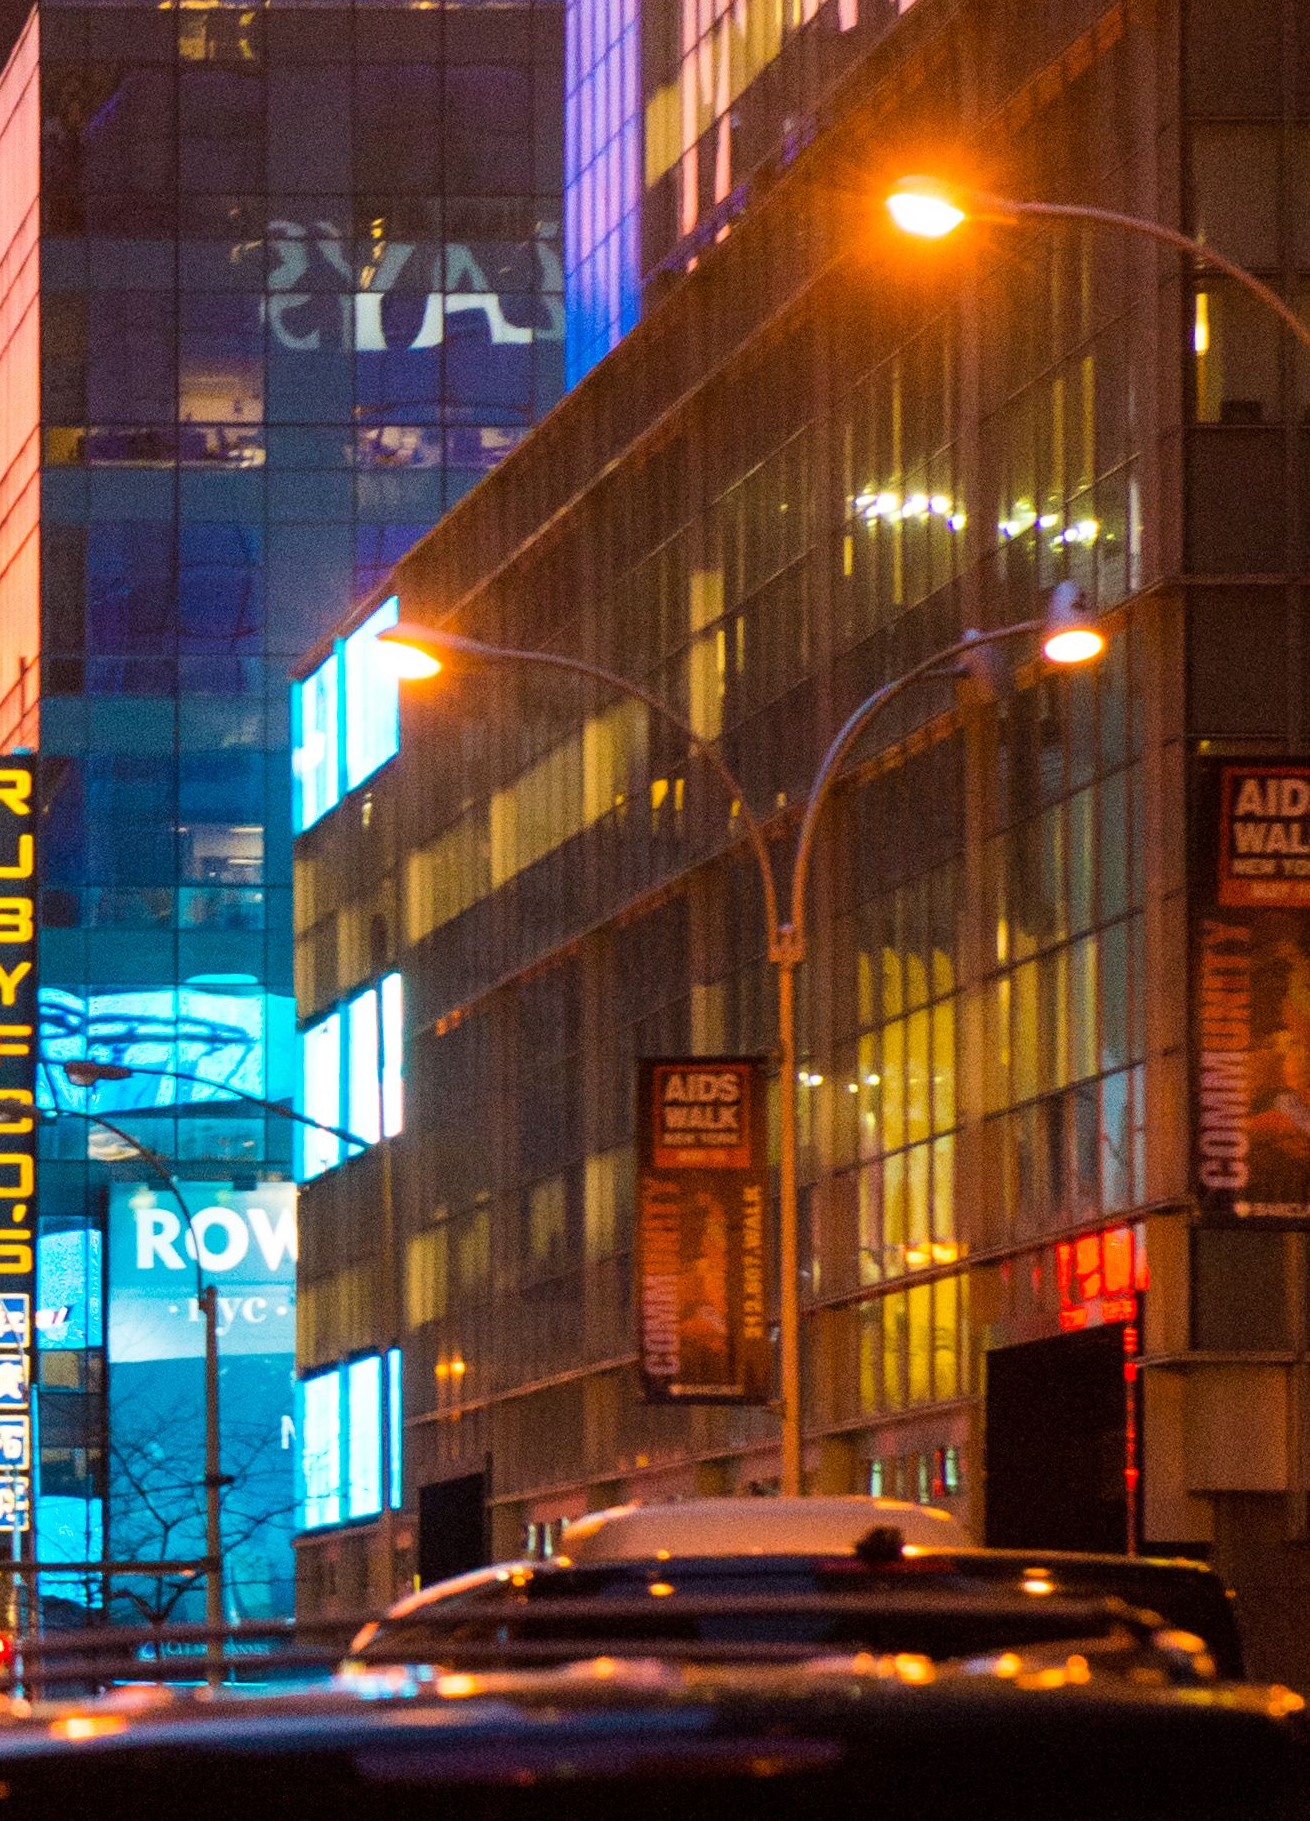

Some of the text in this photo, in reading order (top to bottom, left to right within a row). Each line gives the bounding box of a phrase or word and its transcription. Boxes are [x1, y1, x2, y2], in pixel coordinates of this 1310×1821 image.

[1236, 779, 1310, 817] AID
[1235, 823, 1310, 855] WAL
[664, 1075, 740, 1102] AIDS
[662, 1107, 739, 1130] WALK
